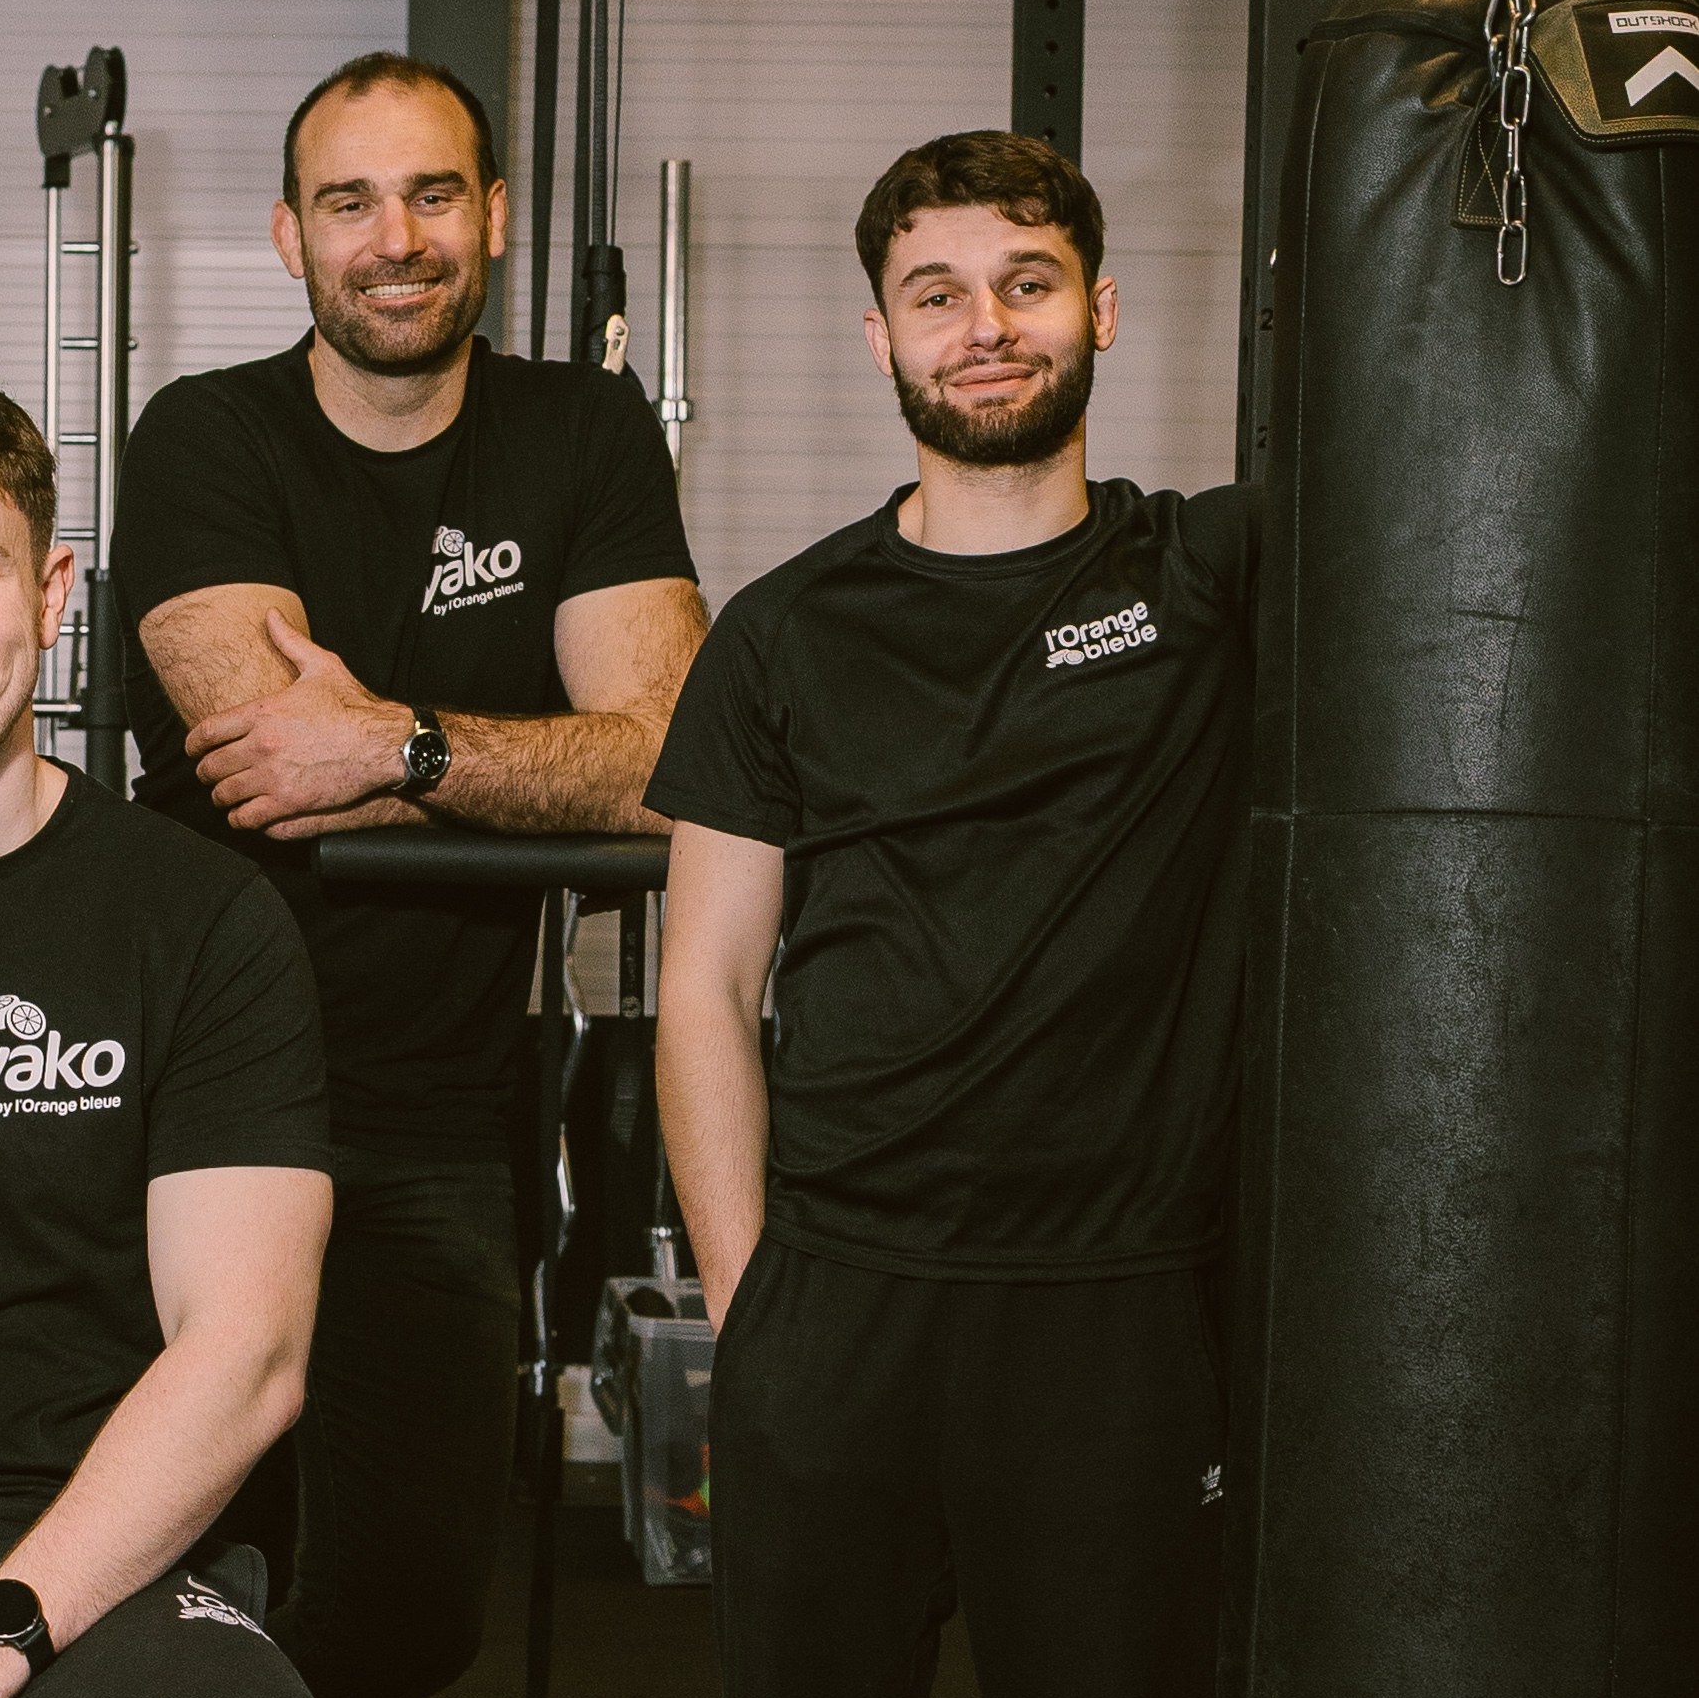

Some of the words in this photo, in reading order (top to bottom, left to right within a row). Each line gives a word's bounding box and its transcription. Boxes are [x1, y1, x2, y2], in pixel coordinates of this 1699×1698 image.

[1615, 15, 1698, 30] OUTSHOCK
[433, 604, 447, 616] by
[493, 582, 524, 597] bleue
[1045, 601, 1148, 652] l'Orange
[1083, 624, 1157, 659] bleue
[15, 1098, 77, 1116] l'Orange
[80, 1096, 121, 1110] bleue
